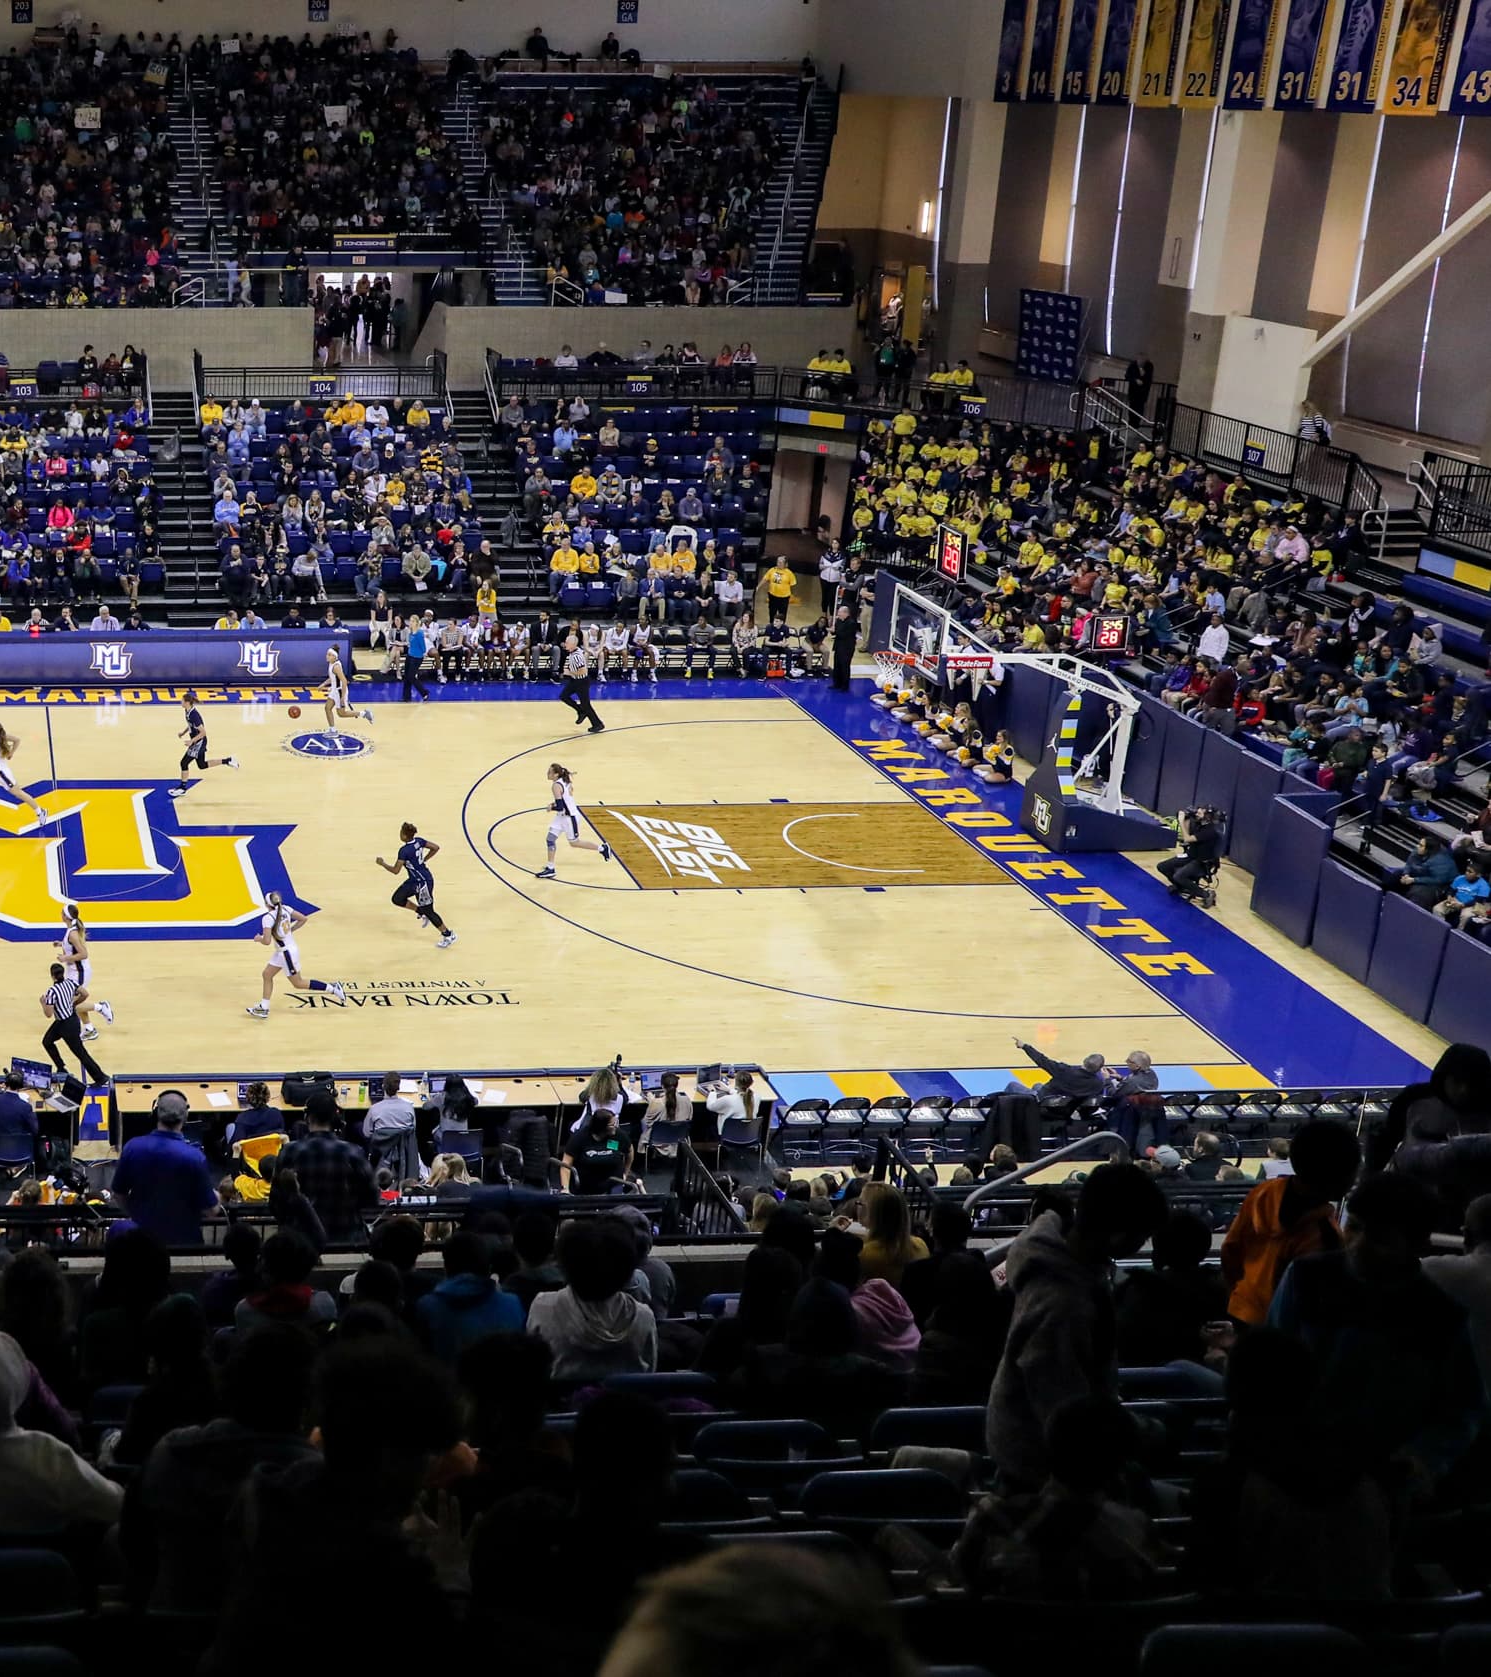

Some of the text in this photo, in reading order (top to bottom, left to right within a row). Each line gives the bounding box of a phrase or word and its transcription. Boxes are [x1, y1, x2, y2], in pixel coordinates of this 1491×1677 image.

[16, 11, 29, 20] GA
[312, 10, 325, 20] GA
[620, 1, 635, 10] 205
[621, 12, 634, 21] GA
[1032, 71, 1046, 94] 14
[1065, 71, 1083, 96] 15
[1101, 71, 1121, 96] 20
[1142, 73, 1161, 95] 21
[1185, 72, 1207, 97] 22
[1230, 71, 1255, 99] 24
[1280, 71, 1306, 100] 31
[1335, 71, 1362, 101] 31
[1392, 74, 1424, 107] 34
[1429, 64, 1441, 102] ABBIE
[1460, 70, 1491, 103] 43
[15, 385, 32, 396] 103
[314, 382, 331, 393] 104
[631, 382, 648, 393] 105
[962, 403, 981, 415] 106
[1247, 448, 1261, 464] 107
[943, 547, 960, 574] 28
[1102, 619, 1124, 631] 5:45
[1100, 631, 1118, 645] 28
[90, 641, 133, 679] MU
[237, 640, 281, 677] MU
[1031, 792, 1053, 836] MU
[630, 814, 723, 885] EAST
[671, 820, 751, 872] BIG
[852, 739, 1215, 978] MARQUETTE
[284, 992, 520, 1009] TOWN BANK
